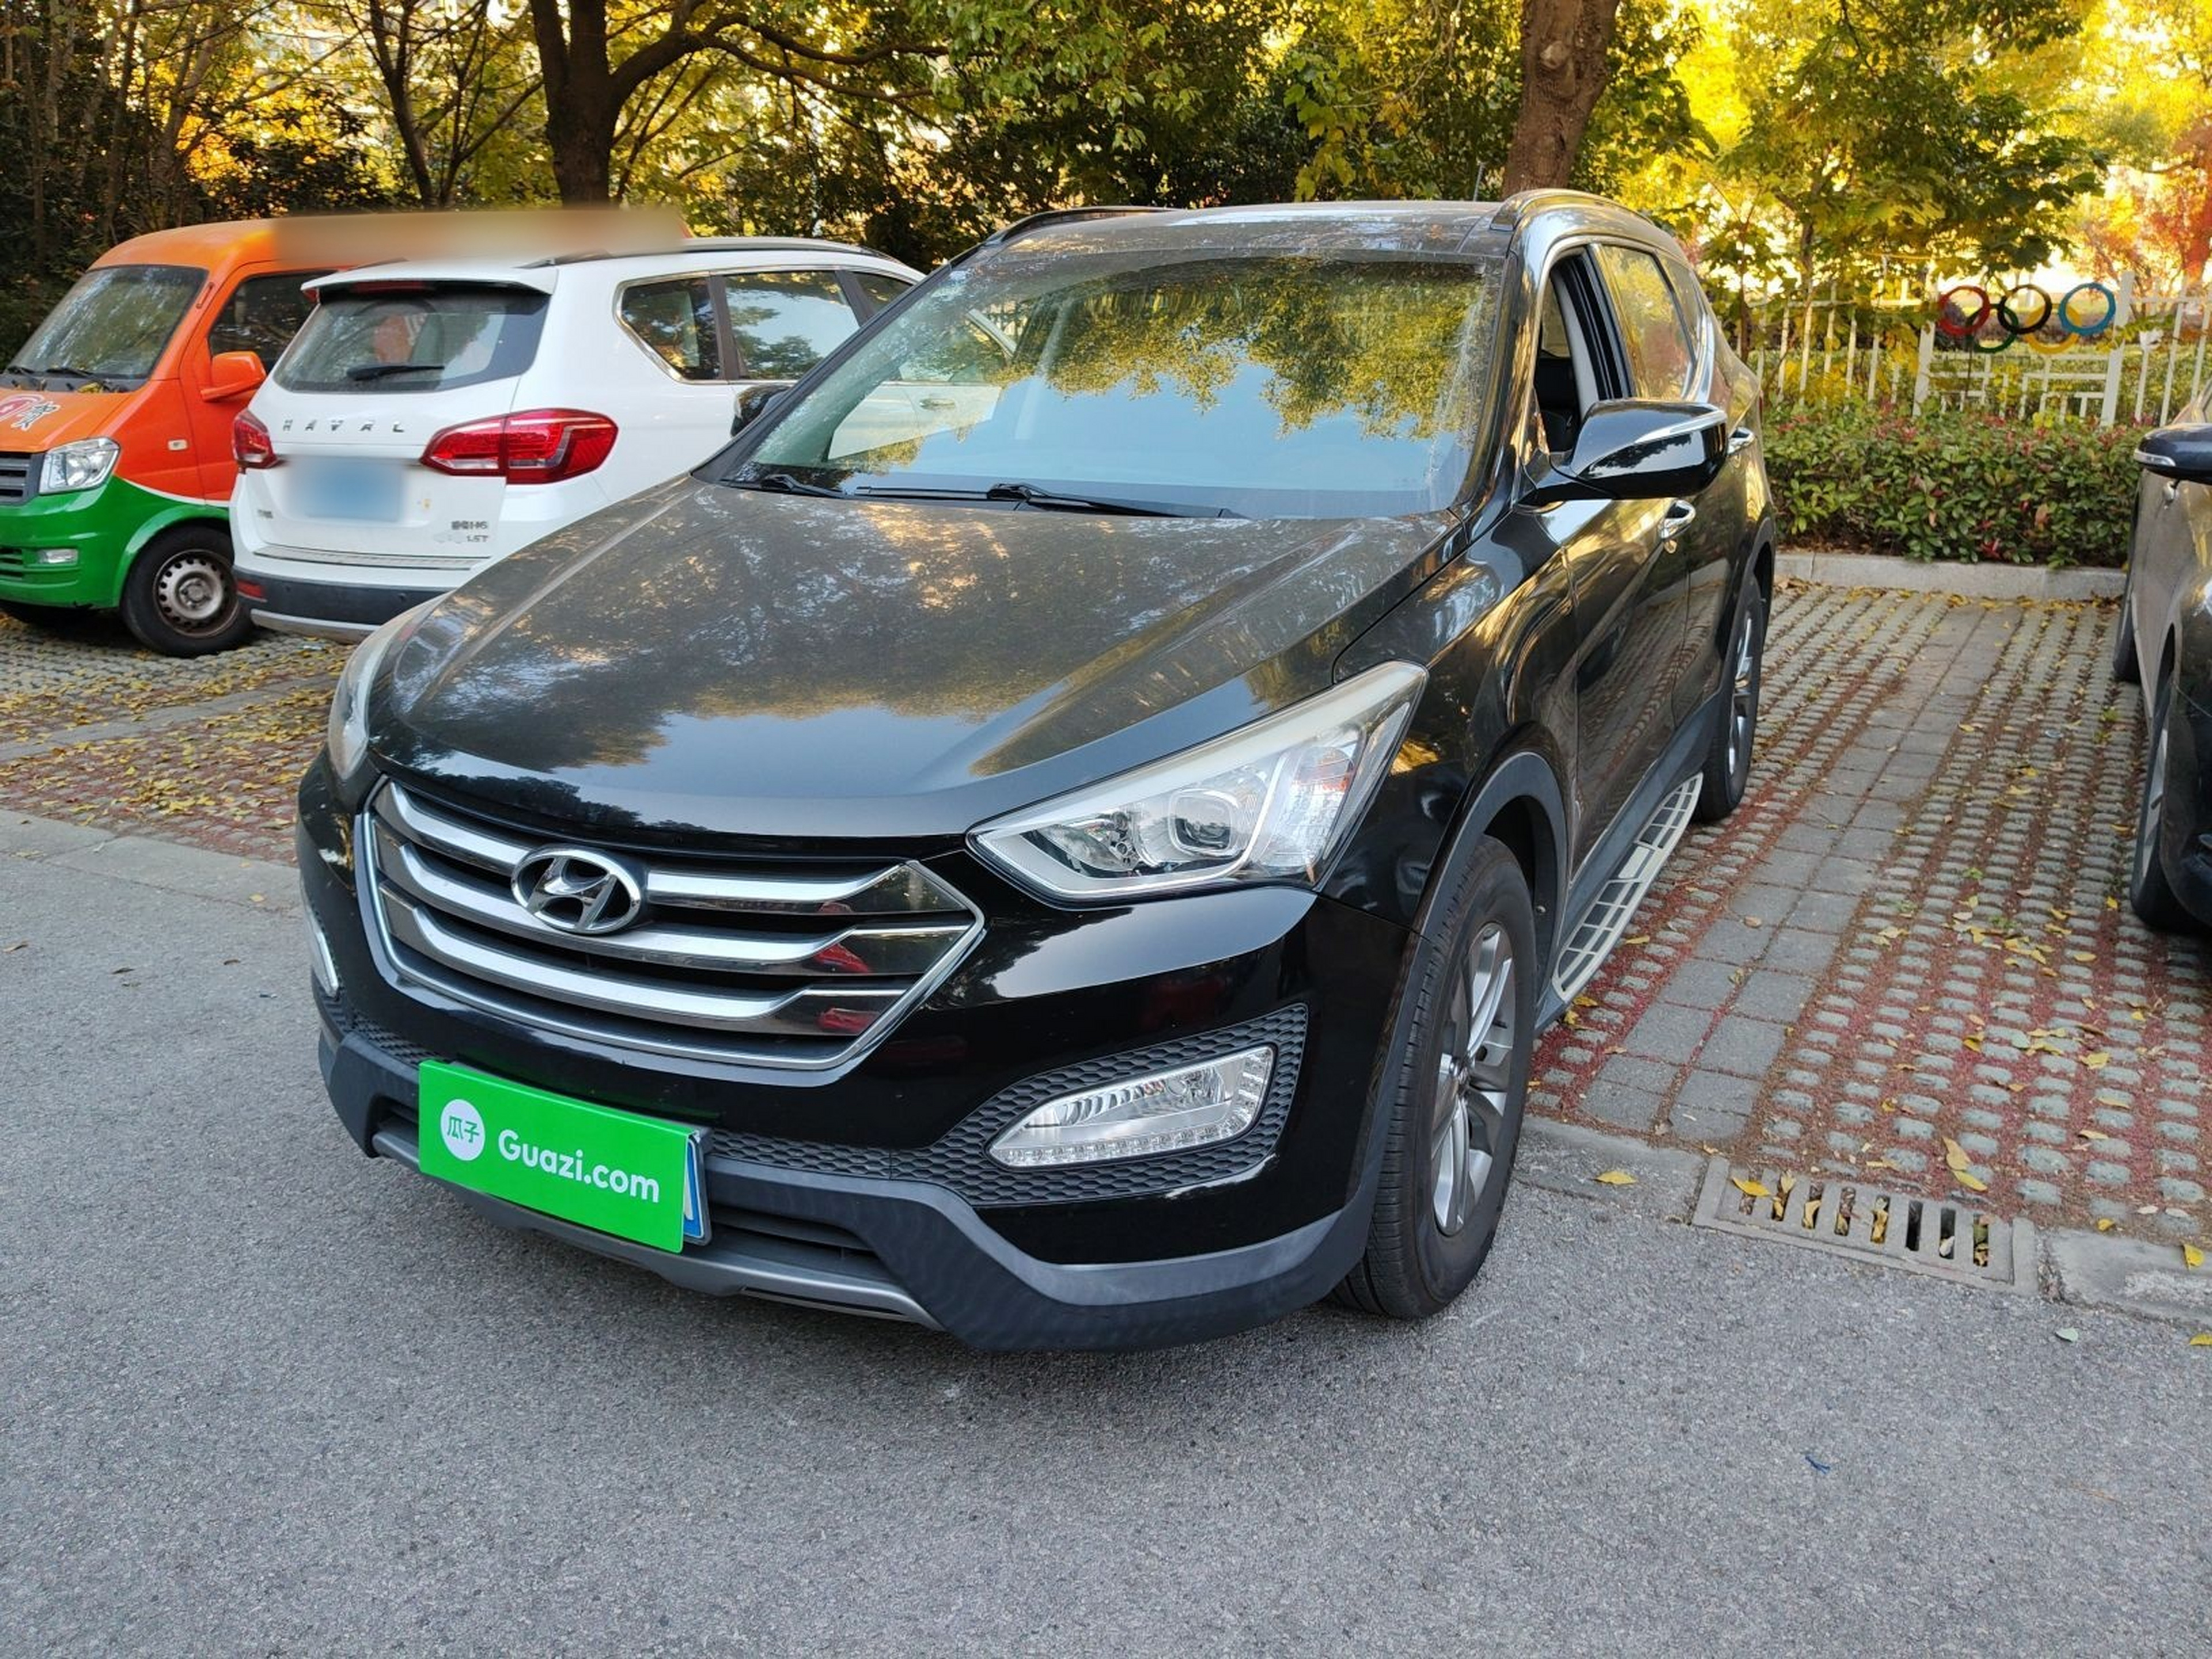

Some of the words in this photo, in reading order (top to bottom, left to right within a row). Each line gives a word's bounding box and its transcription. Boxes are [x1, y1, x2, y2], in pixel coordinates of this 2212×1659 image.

[282, 419, 404, 433] HAVAL
[447, 1115, 480, 1143] 瓜子
[498, 1129, 660, 1203] Guazi.com
